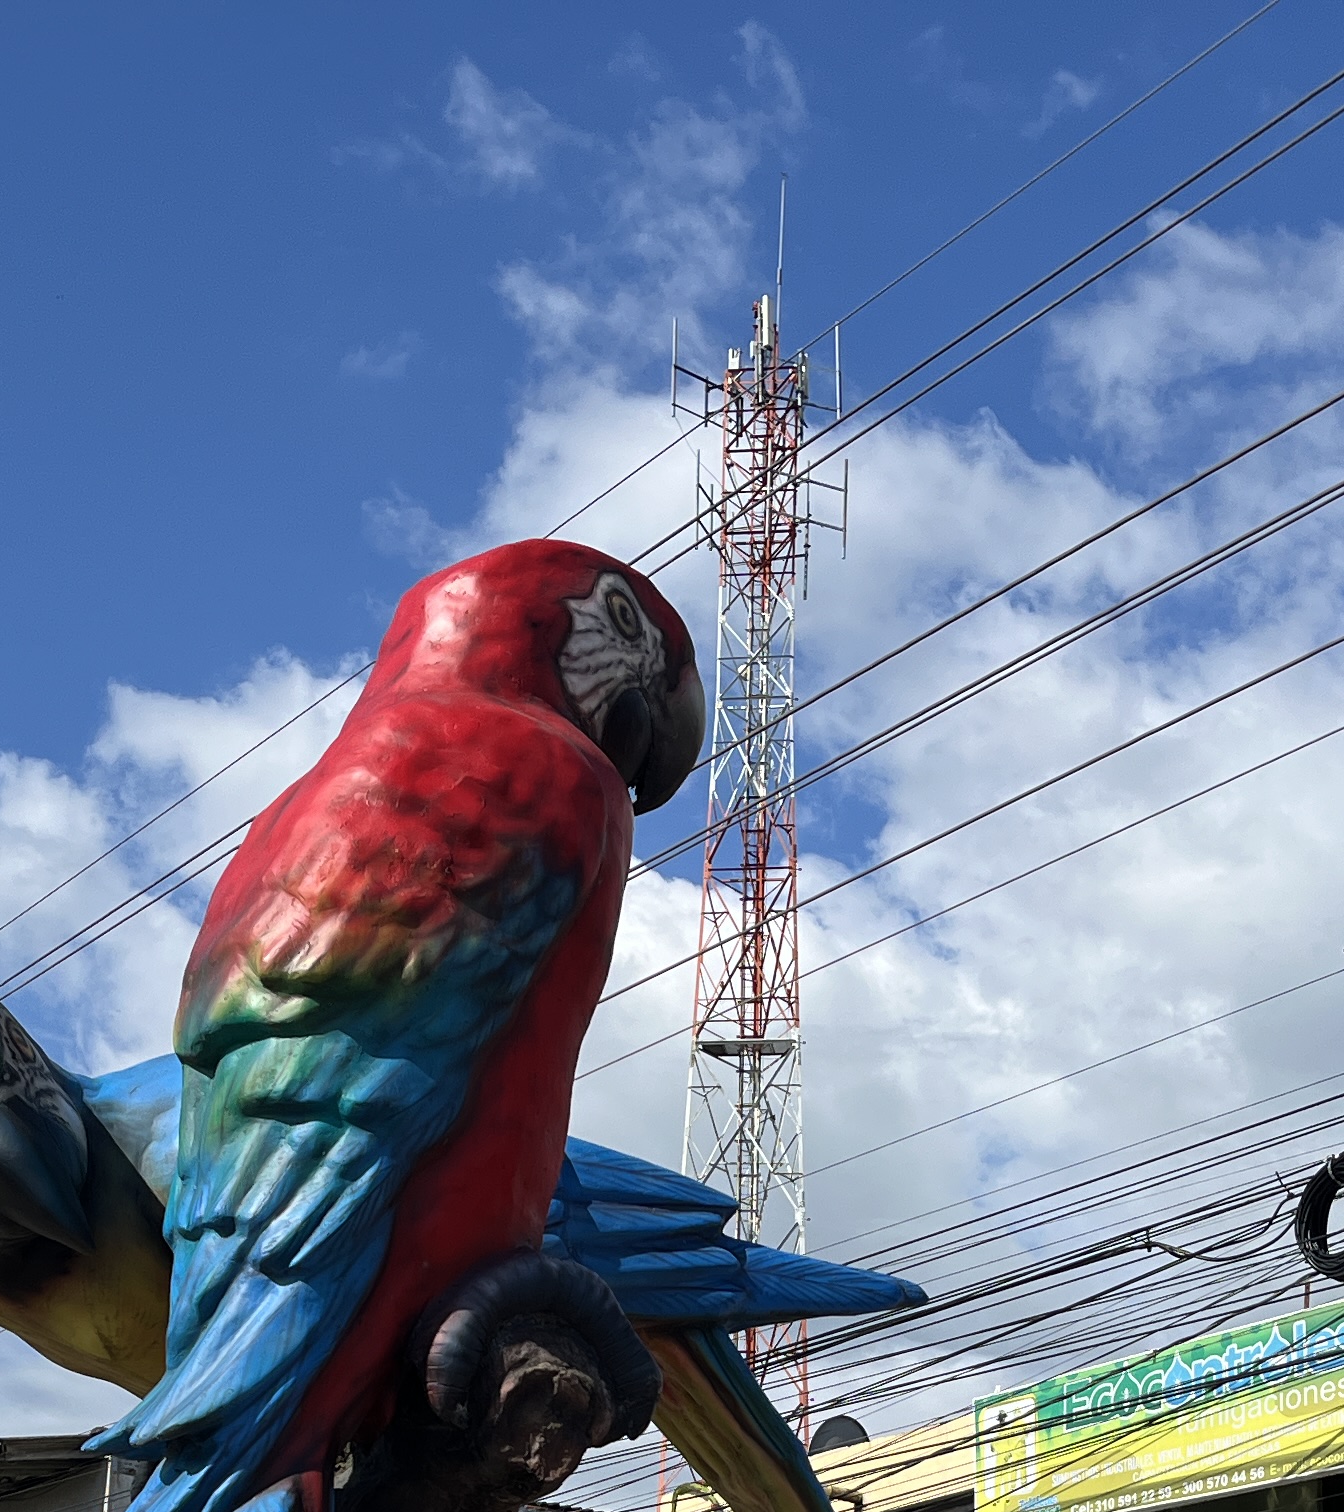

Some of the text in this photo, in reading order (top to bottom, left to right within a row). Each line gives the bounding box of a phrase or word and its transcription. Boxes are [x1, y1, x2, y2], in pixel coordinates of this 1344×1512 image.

[1206, 1473, 1229, 1491] 570
[1231, 1469, 1247, 1485] 44
[1249, 1465, 1266, 1480] 56
